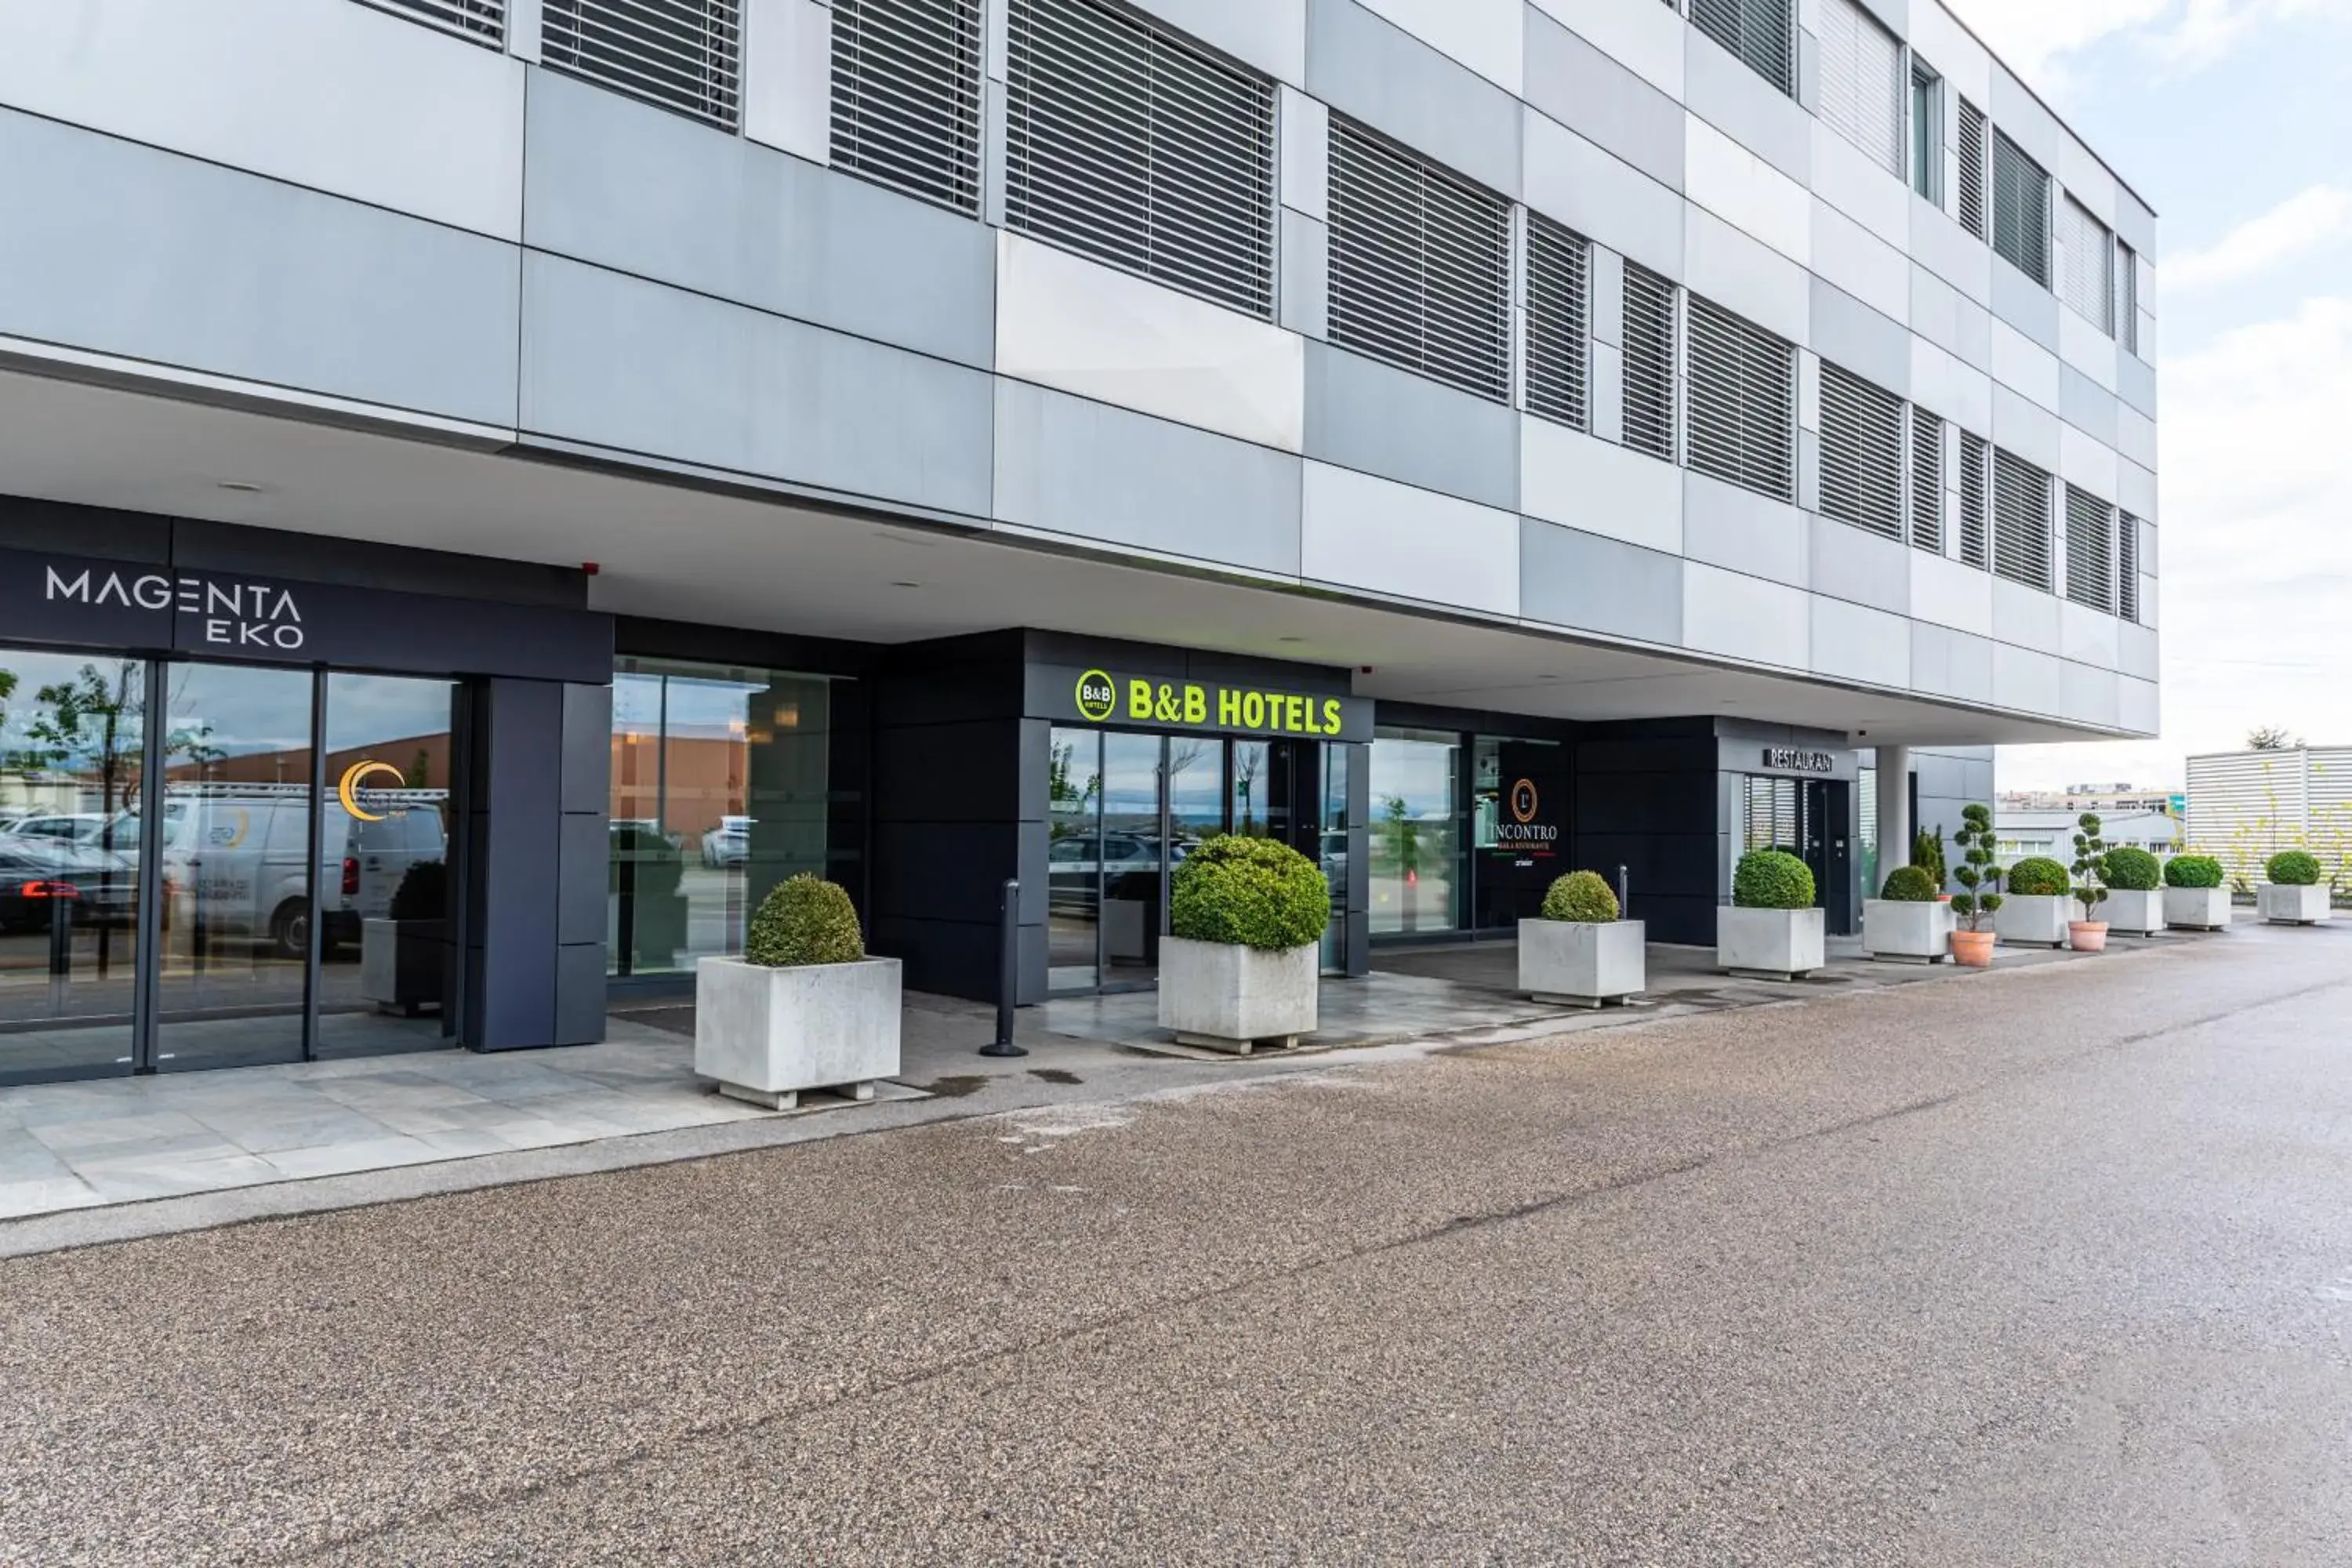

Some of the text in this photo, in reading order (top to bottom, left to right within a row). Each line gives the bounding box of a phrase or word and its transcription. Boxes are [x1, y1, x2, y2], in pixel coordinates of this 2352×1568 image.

[46, 565, 302, 622] MAGENTA
[206, 619, 304, 649] EKO
[1083, 684, 1110, 702] B&B
[1128, 679, 1342, 735] B&B HOTELS
[1769, 748, 1835, 771] RESTAURANT
